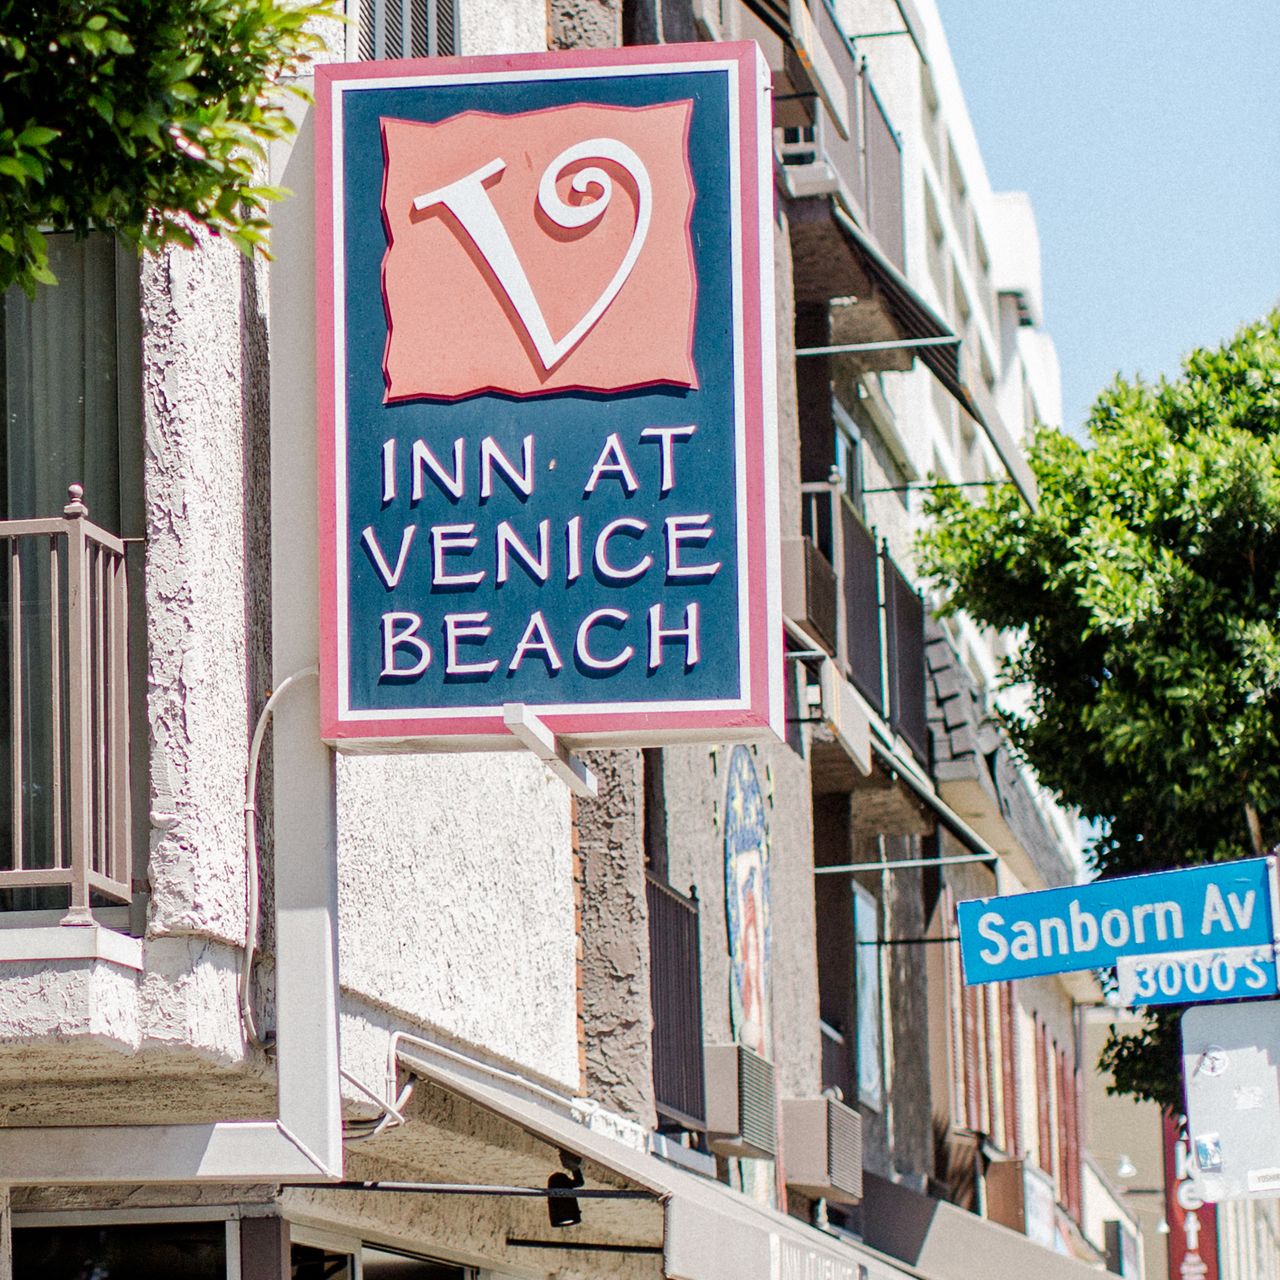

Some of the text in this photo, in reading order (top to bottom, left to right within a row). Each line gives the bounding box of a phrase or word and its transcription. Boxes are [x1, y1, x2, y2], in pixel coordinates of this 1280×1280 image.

[381, 425, 697, 501] INN AT
[361, 513, 720, 589] VENICE
[380, 602, 699, 677] BEACH
[977, 882, 1256, 966] Sanborn Av
[1136, 956, 1236, 998] 3000
